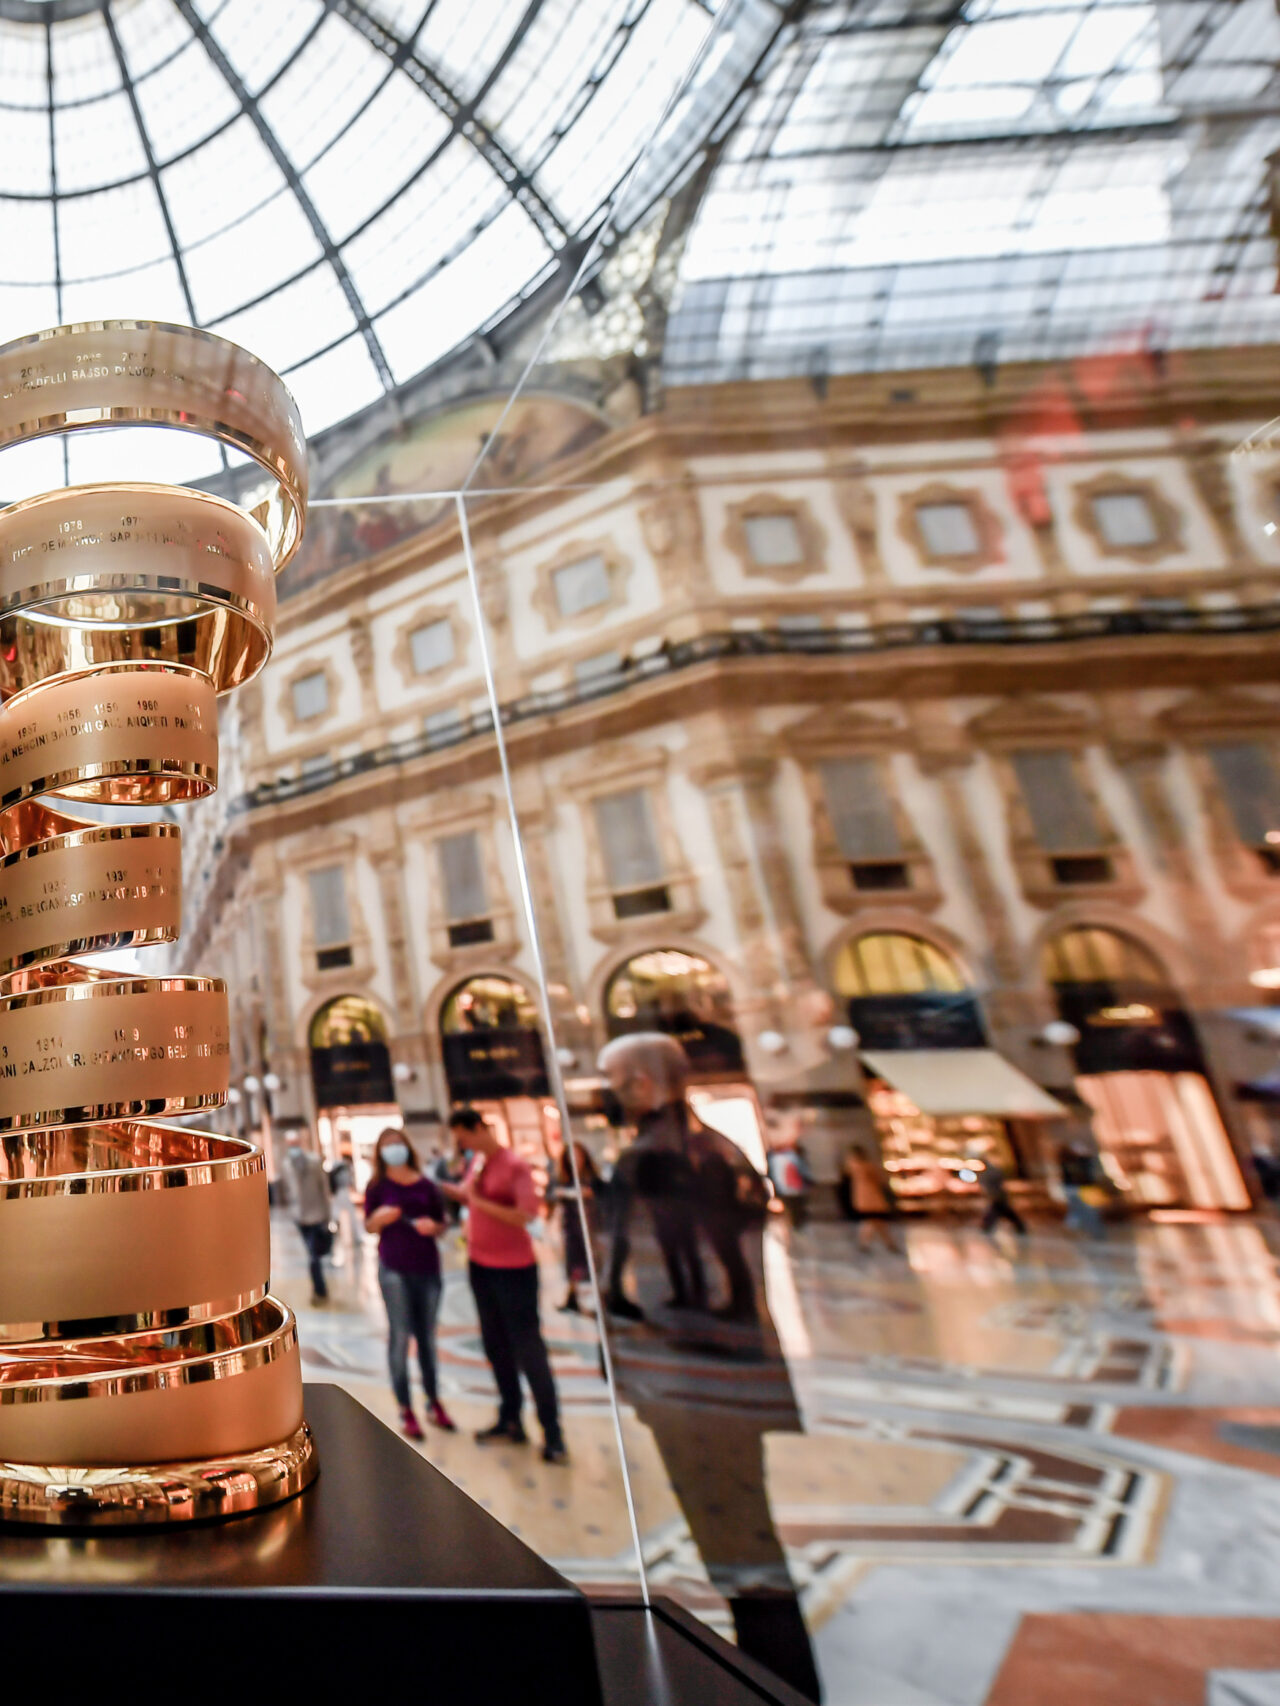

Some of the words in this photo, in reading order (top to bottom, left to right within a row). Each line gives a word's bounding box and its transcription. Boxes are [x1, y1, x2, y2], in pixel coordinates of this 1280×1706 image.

[120, 517, 142, 528] 197
[42, 877, 67, 895] 193
[113, 1027, 140, 1042] 199
